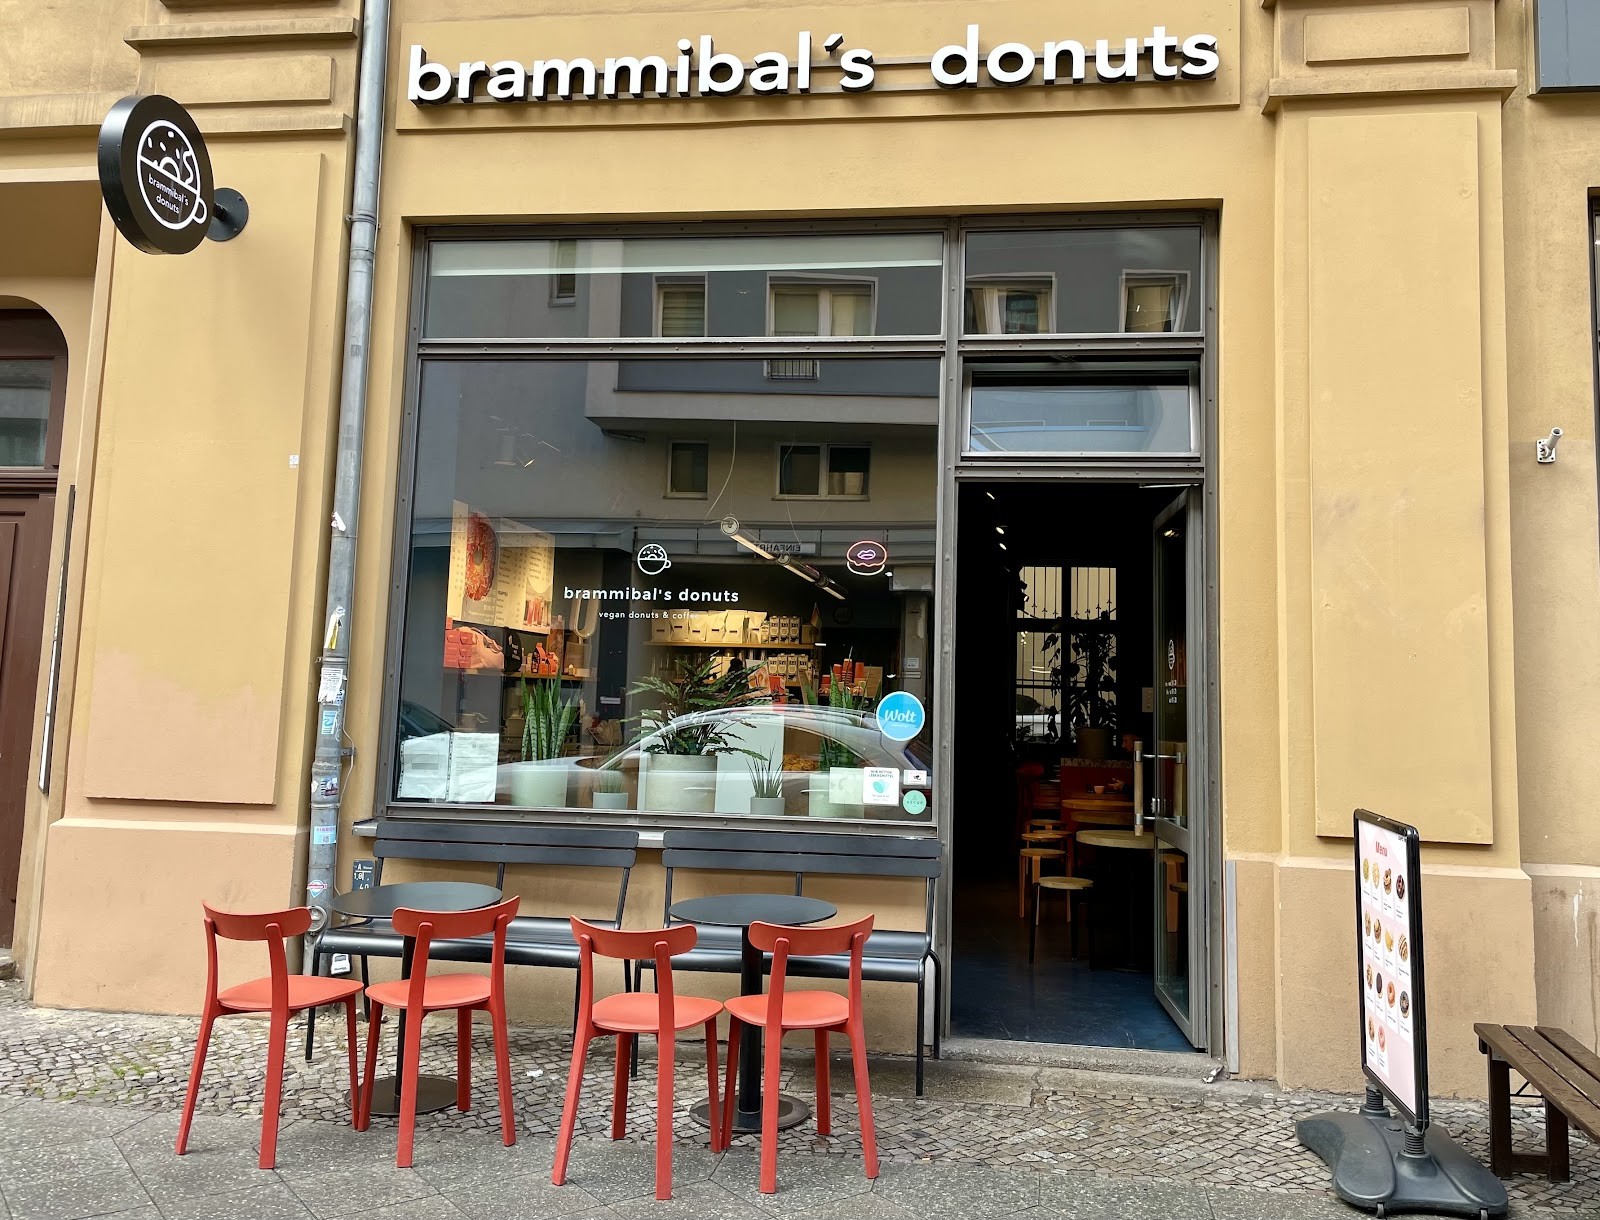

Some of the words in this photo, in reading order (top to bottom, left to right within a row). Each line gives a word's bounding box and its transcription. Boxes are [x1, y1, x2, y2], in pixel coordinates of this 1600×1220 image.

[930, 24, 1220, 86] donuts
[156, 194, 180, 214] donuts
[564, 586, 672, 600] brammibal's
[679, 588, 739, 602] donuts
[599, 611, 626, 620] vegan
[629, 610, 659, 619] donuts
[662, 611, 669, 619] &
[884, 709, 917, 723] Wolt
